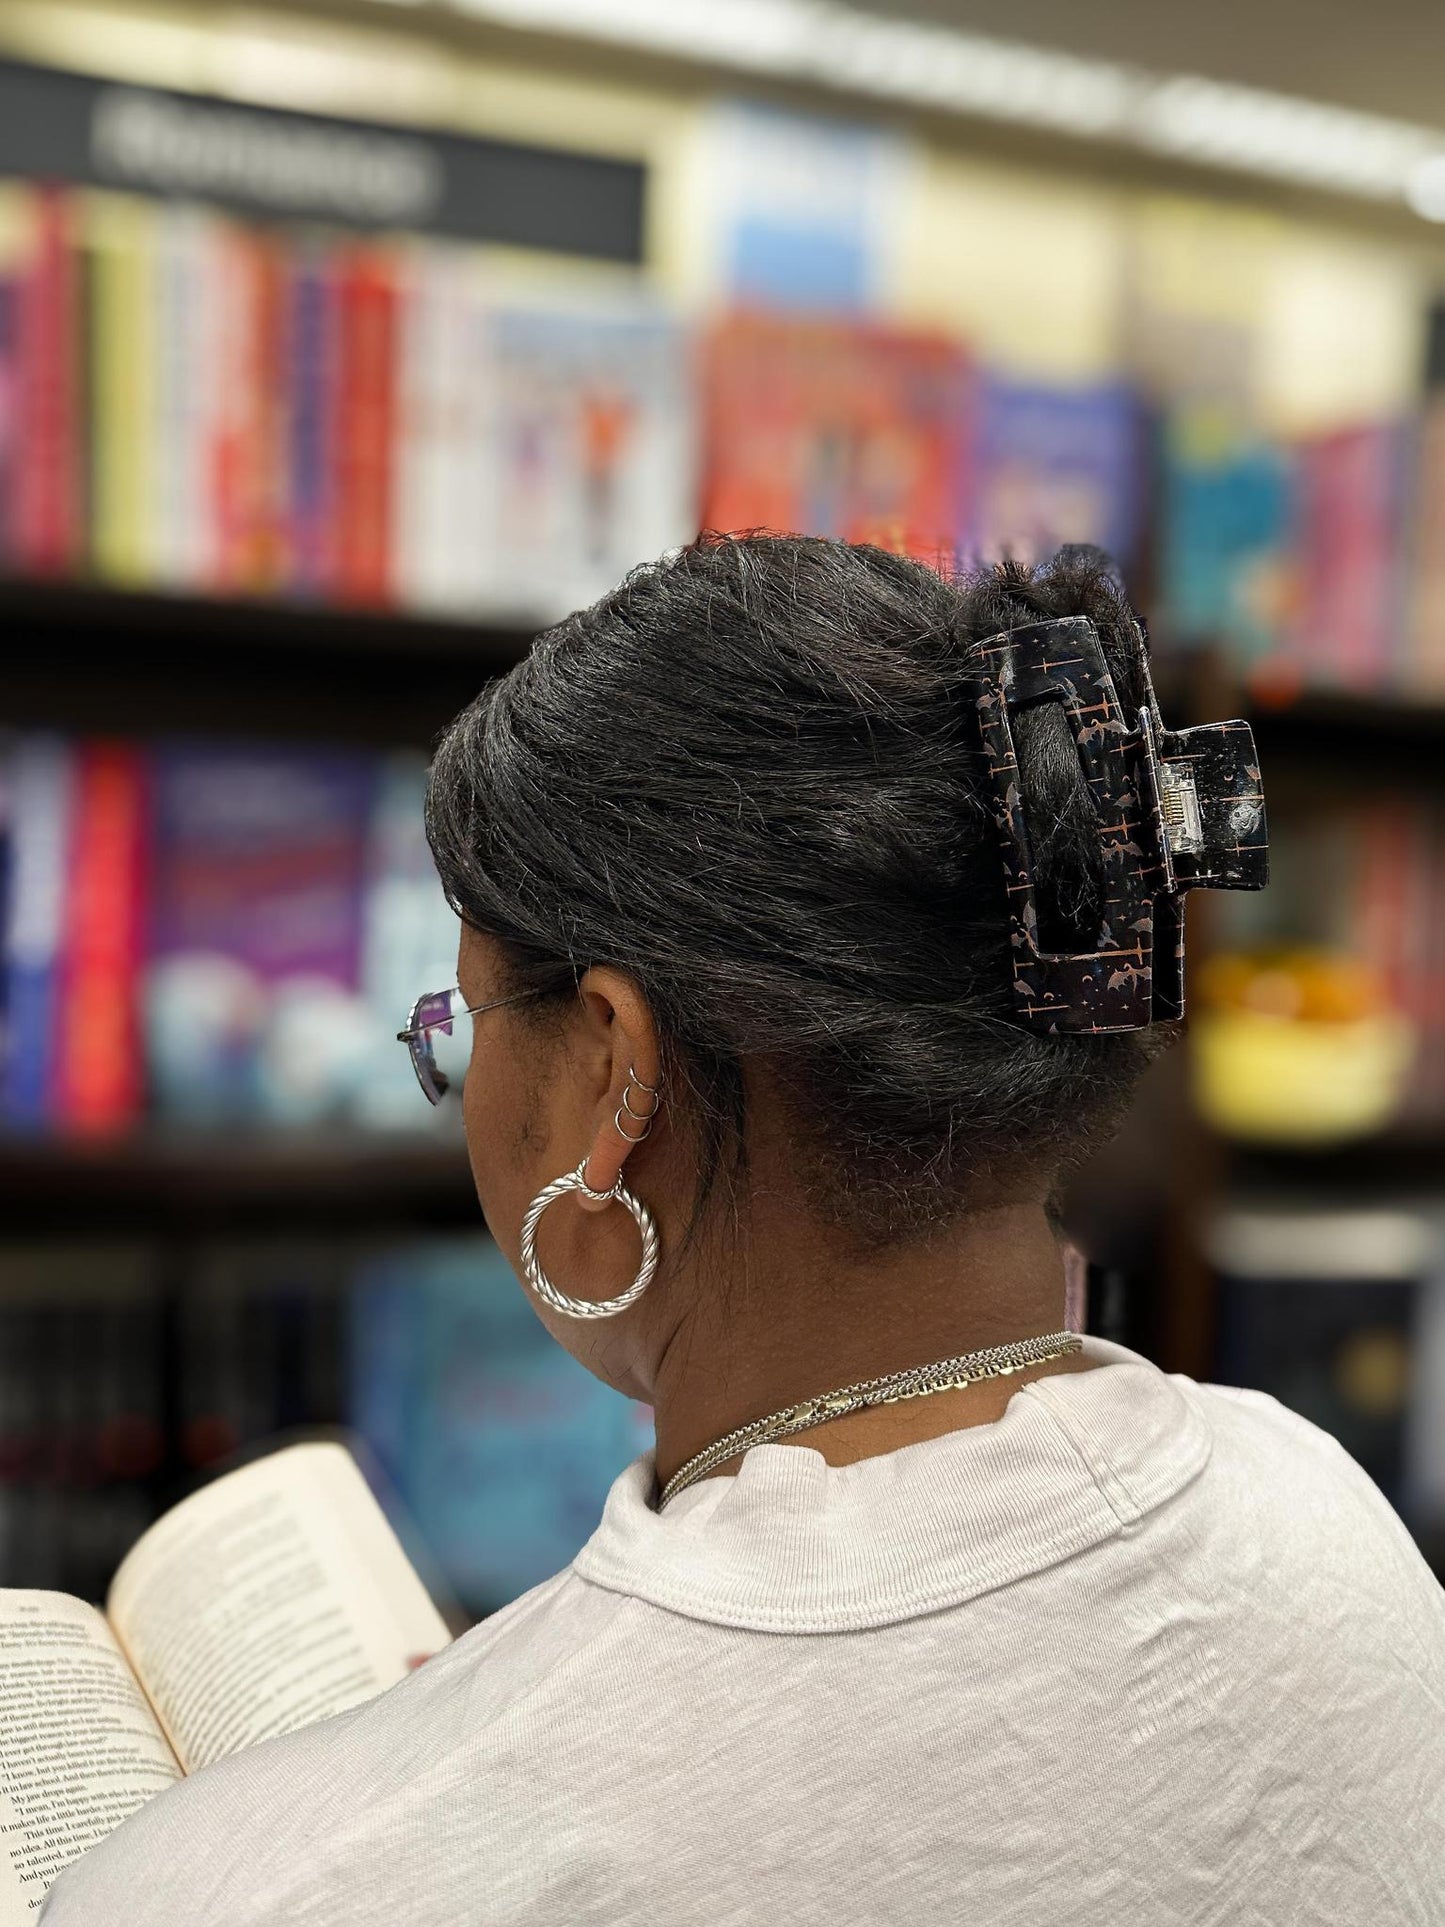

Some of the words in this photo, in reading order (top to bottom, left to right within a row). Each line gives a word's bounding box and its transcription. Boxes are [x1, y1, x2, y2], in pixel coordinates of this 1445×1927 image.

[10, 1784, 19, 1792] in
[19, 1782, 33, 1790] law
[11, 1796, 26, 1804] My
[27, 1794, 40, 1803] jaw
[42, 1790, 64, 1799] drops
[0, 1824, 8, 1833] it
[9, 1820, 36, 1831] makes
[36, 1814, 50, 1824] life
[56, 1810, 76, 1820] little
[15, 1808, 24, 1816] "I
[24, 1830, 44, 1840] This
[46, 1826, 64, 1835] time
[65, 1822, 70, 1830] I
[72, 1816, 105, 1828] carefully
[106, 1814, 122, 1823] pick
[10, 1850, 22, 1858] no
[22, 1844, 43, 1854] idea.
[44, 1838, 56, 1849] All
[56, 1836, 72, 1846] this
[94, 1830, 98, 1838] I
[14, 1862, 24, 1870] so
[27, 1850, 66, 1867] talented,
[66, 1845, 82, 1856] and
[19, 1870, 38, 1884] And
[38, 1866, 54, 1880] you
